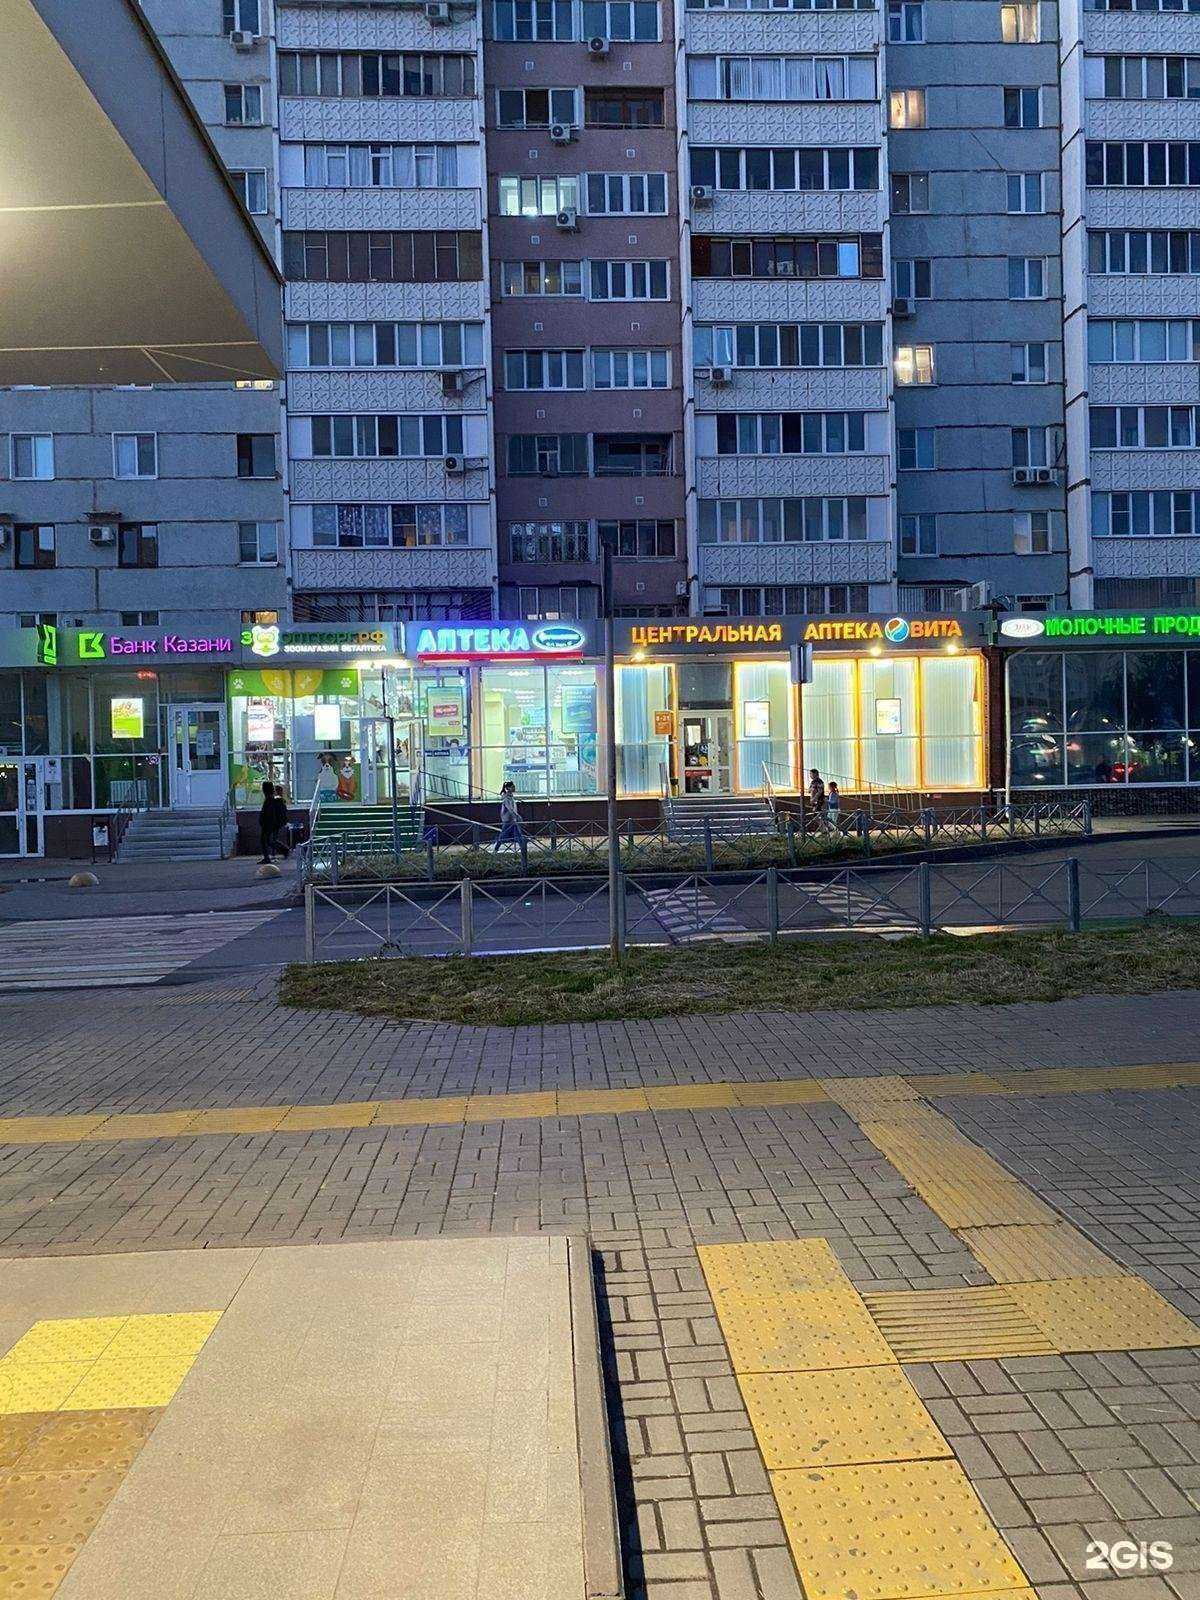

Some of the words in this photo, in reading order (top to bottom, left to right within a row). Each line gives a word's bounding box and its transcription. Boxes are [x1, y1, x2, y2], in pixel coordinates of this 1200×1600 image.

[631, 624, 783, 647] ЦЕНТРАЛЬНАЯ
[804, 622, 883, 641] АПТЕКА
[910, 620, 963, 639] ВИТА
[1045, 617, 1146, 636] МОЛОЧНЫЕ
[110, 636, 157, 655] Банк
[163, 634, 232, 653] Казани
[417, 627, 531, 652] АПТЕКА
